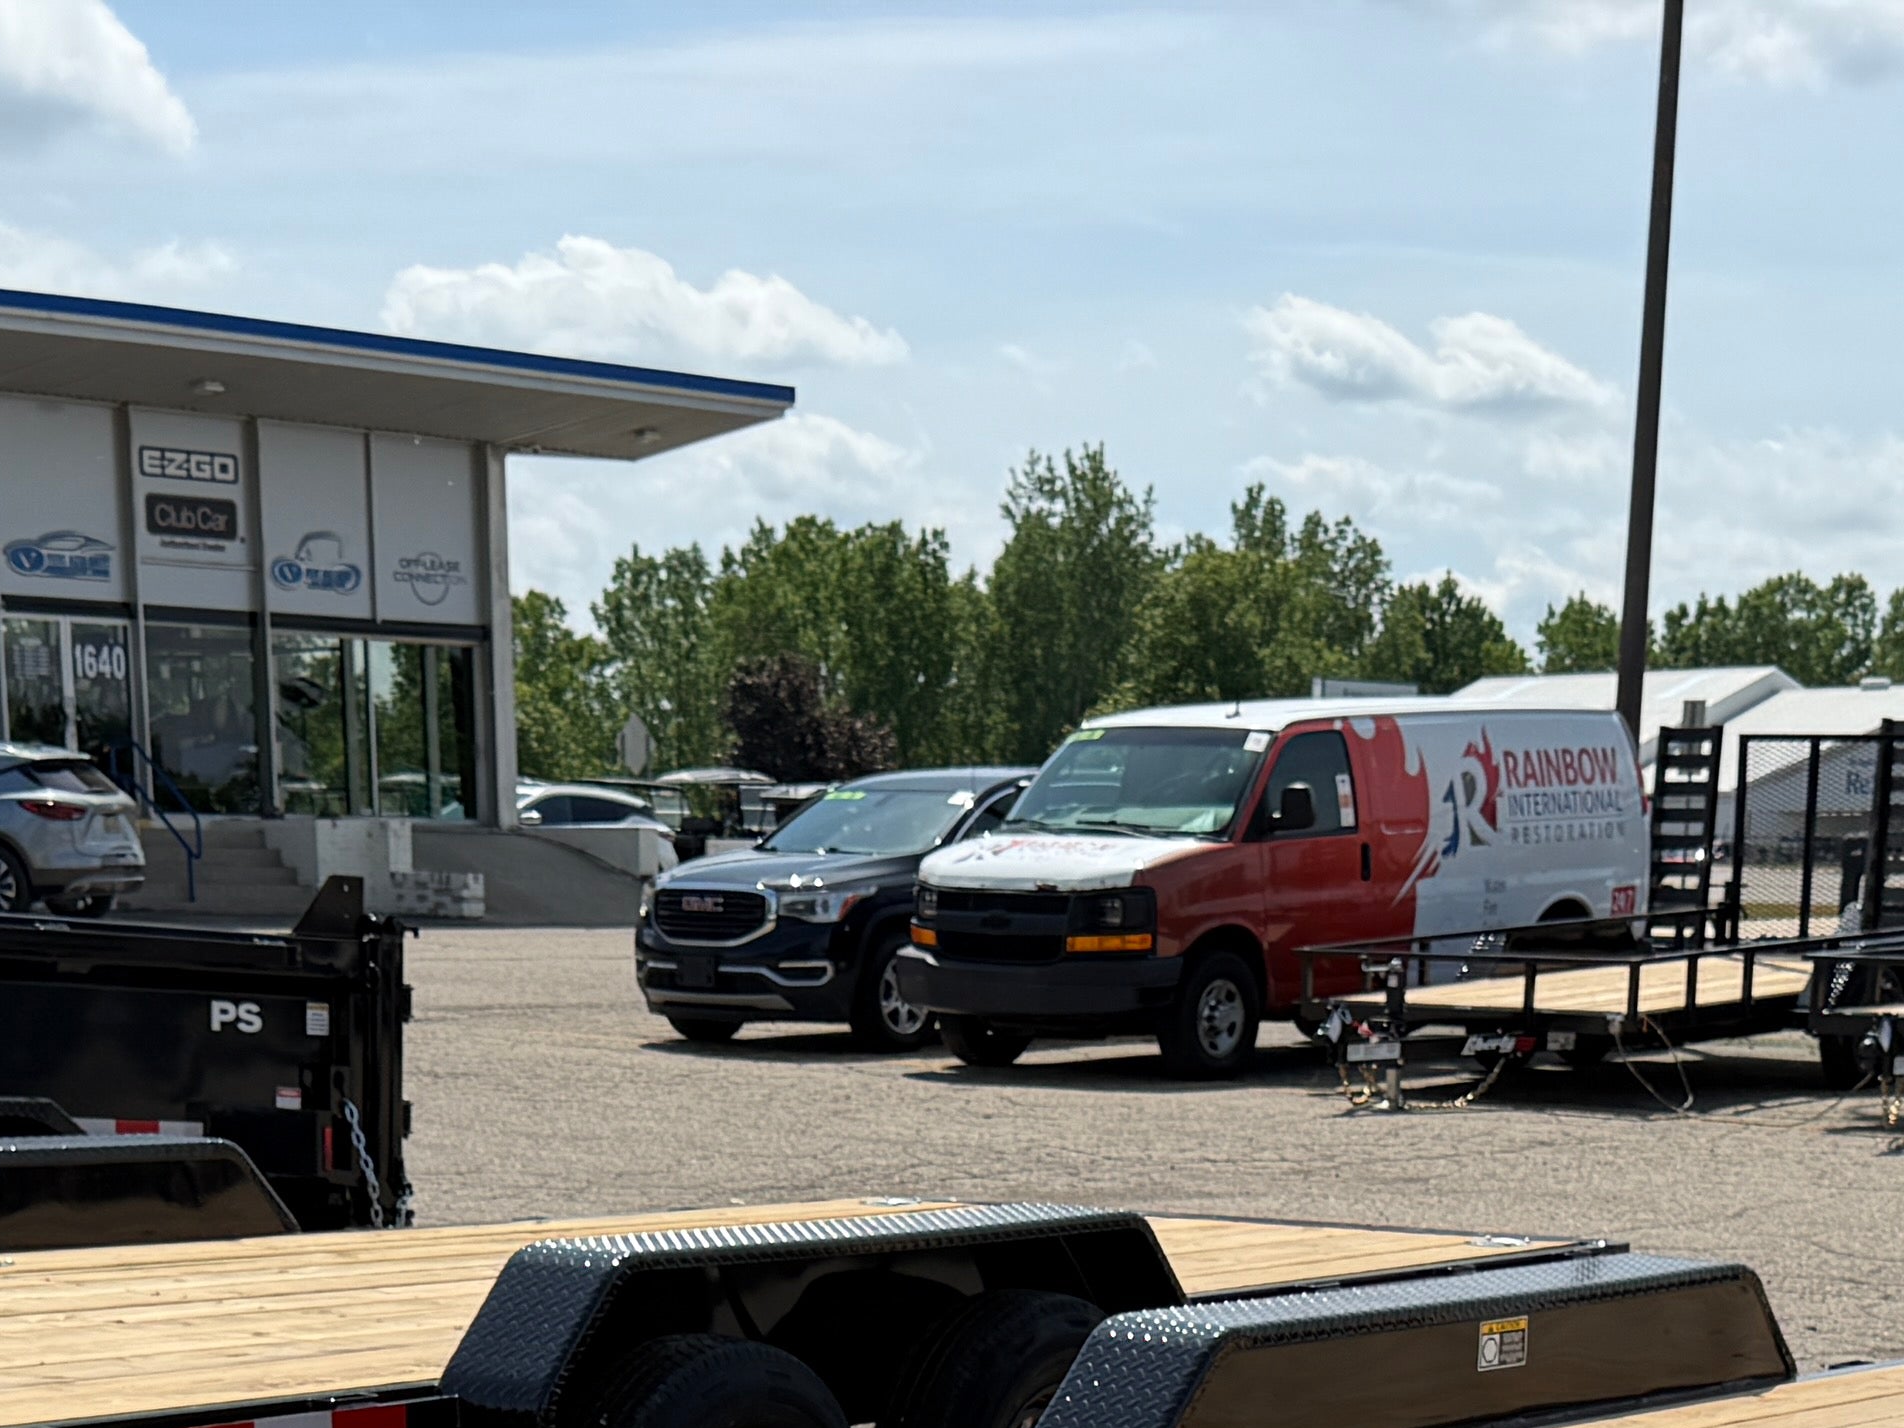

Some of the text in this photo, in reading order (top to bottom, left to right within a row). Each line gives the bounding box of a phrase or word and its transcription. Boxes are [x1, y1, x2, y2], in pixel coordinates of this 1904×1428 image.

[154, 503, 228, 531] Club Car
[74, 643, 126, 681] 1640
[1503, 746, 1617, 788] RAINBOW
[1507, 789, 1624, 817] INTERNATIONAL
[1510, 821, 1625, 845] RESTORATION
[210, 1000, 263, 1033] PS
